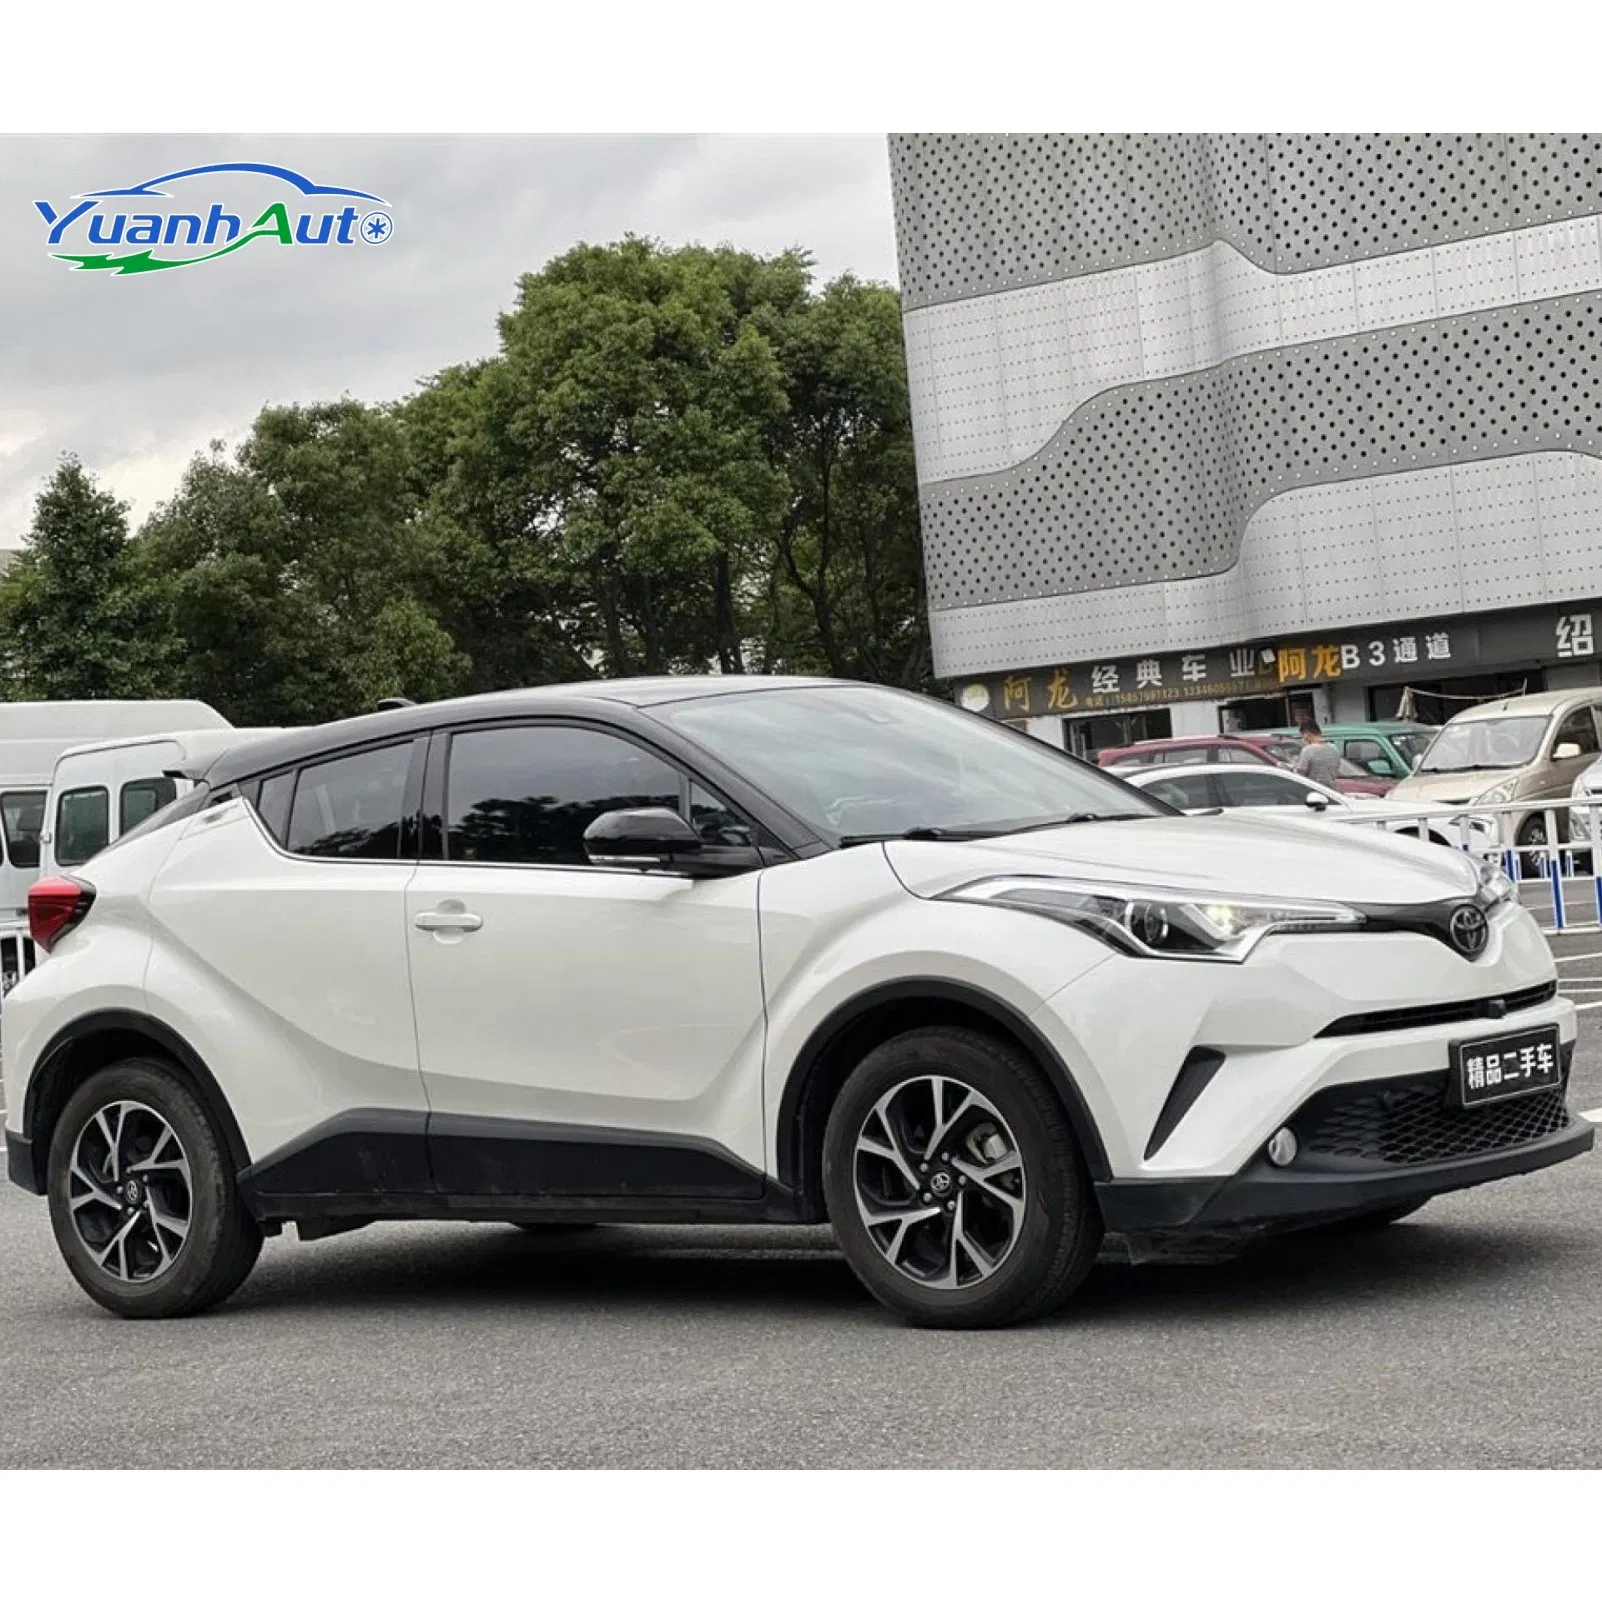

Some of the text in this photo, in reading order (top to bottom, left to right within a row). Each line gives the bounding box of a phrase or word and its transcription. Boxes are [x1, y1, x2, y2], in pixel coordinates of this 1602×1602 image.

[1556, 614, 1594, 657] 绍
[1466, 1043, 1554, 1090] 精品二手车
